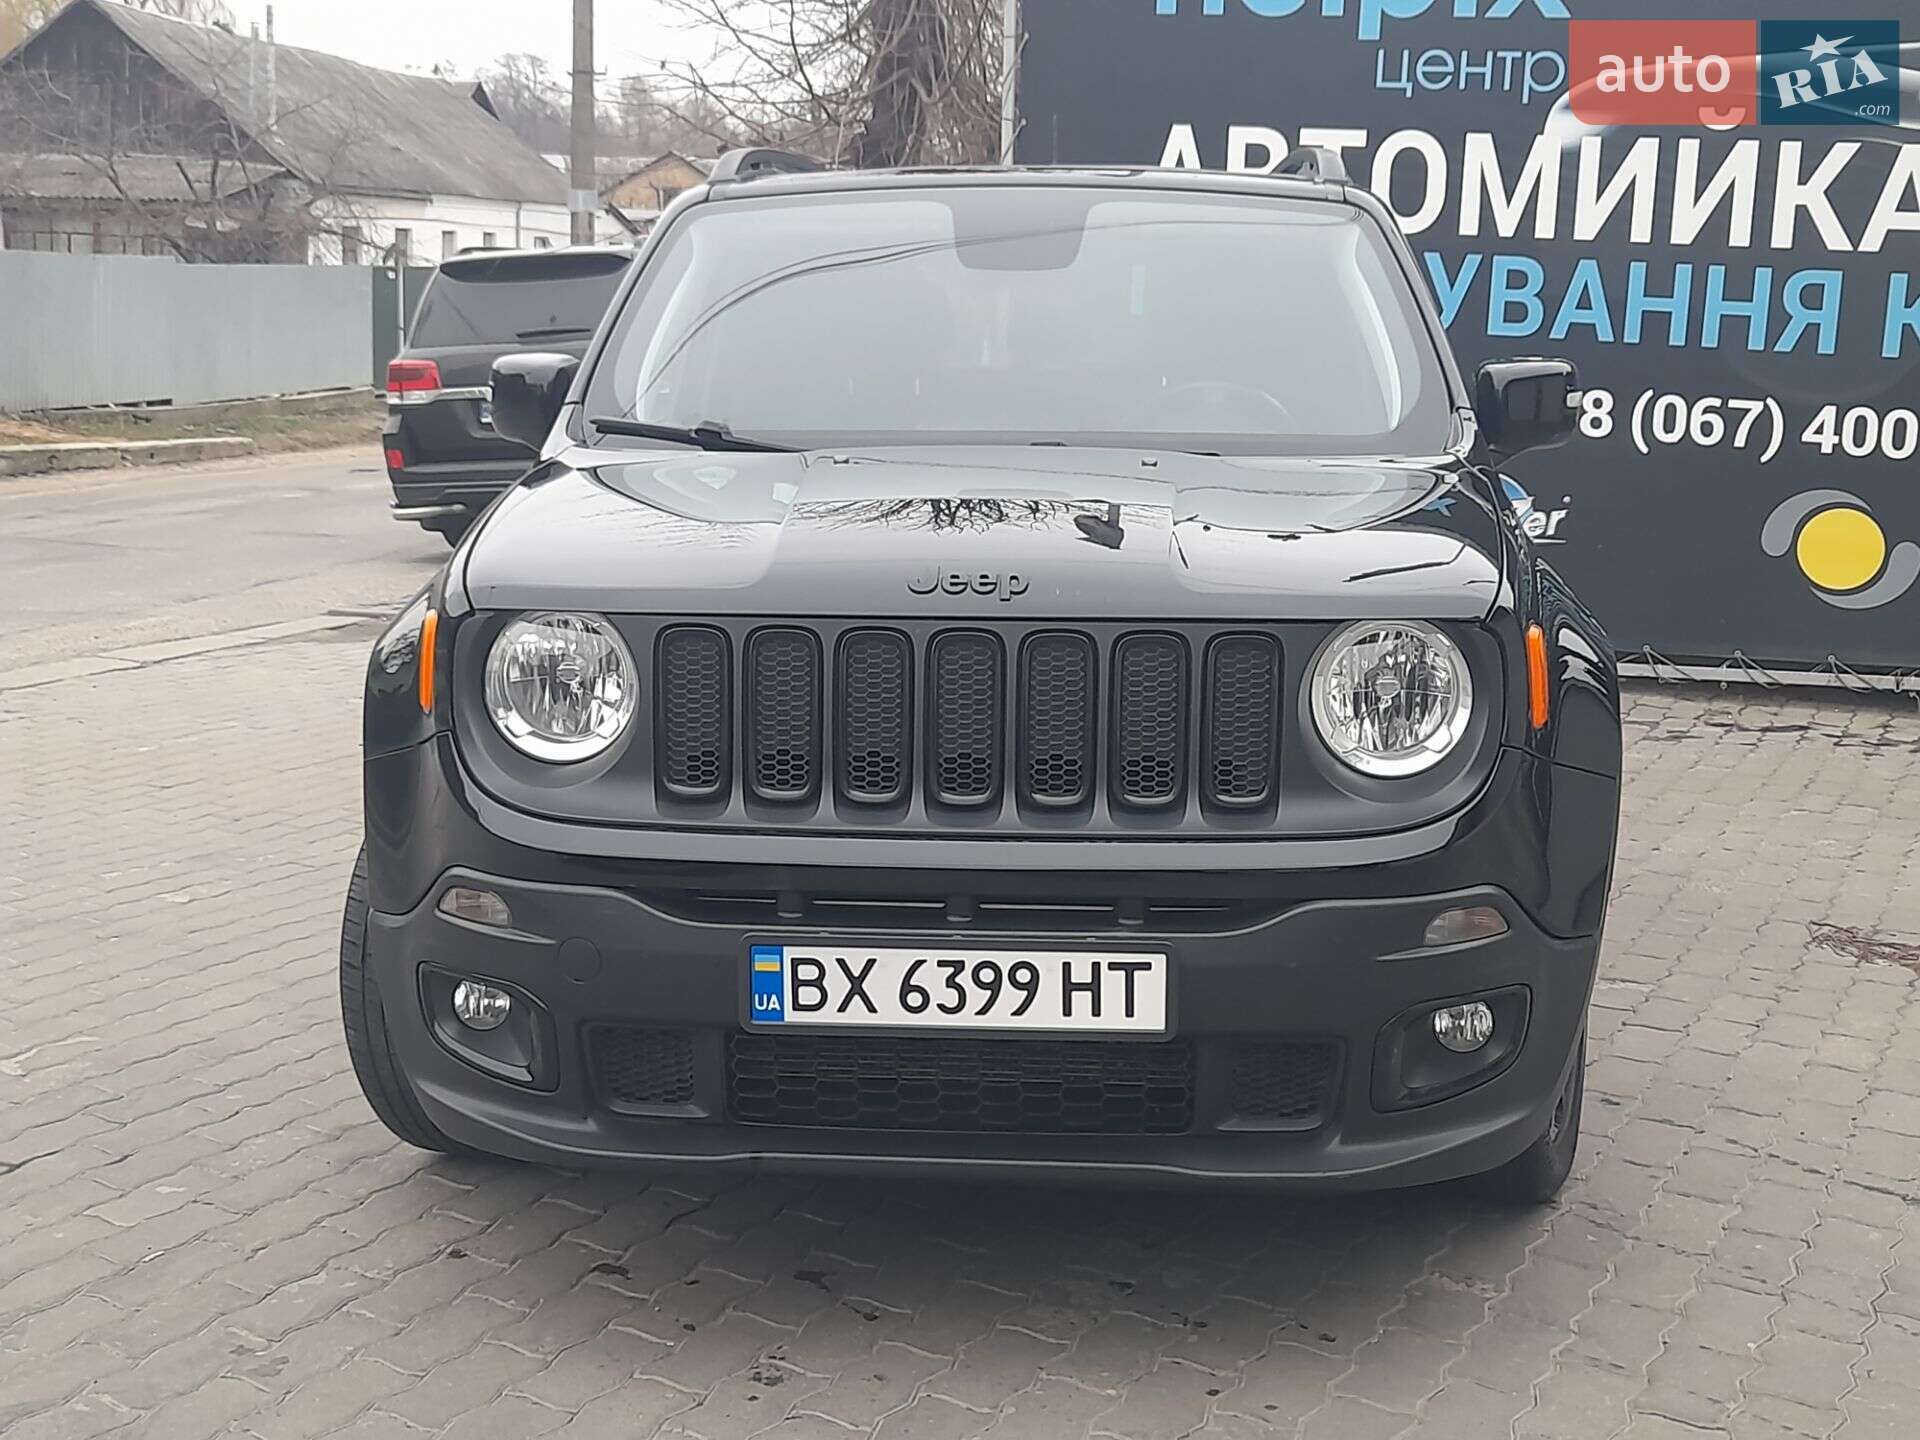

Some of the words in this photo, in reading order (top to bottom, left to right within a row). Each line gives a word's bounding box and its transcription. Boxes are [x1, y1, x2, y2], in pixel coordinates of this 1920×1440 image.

[1374, 48, 1567, 104] центр
[1631, 388, 1784, 464] (067)
[906, 563, 1030, 602] Jeep
[754, 993, 781, 1012] UA
[900, 959, 1040, 1016] 6399
